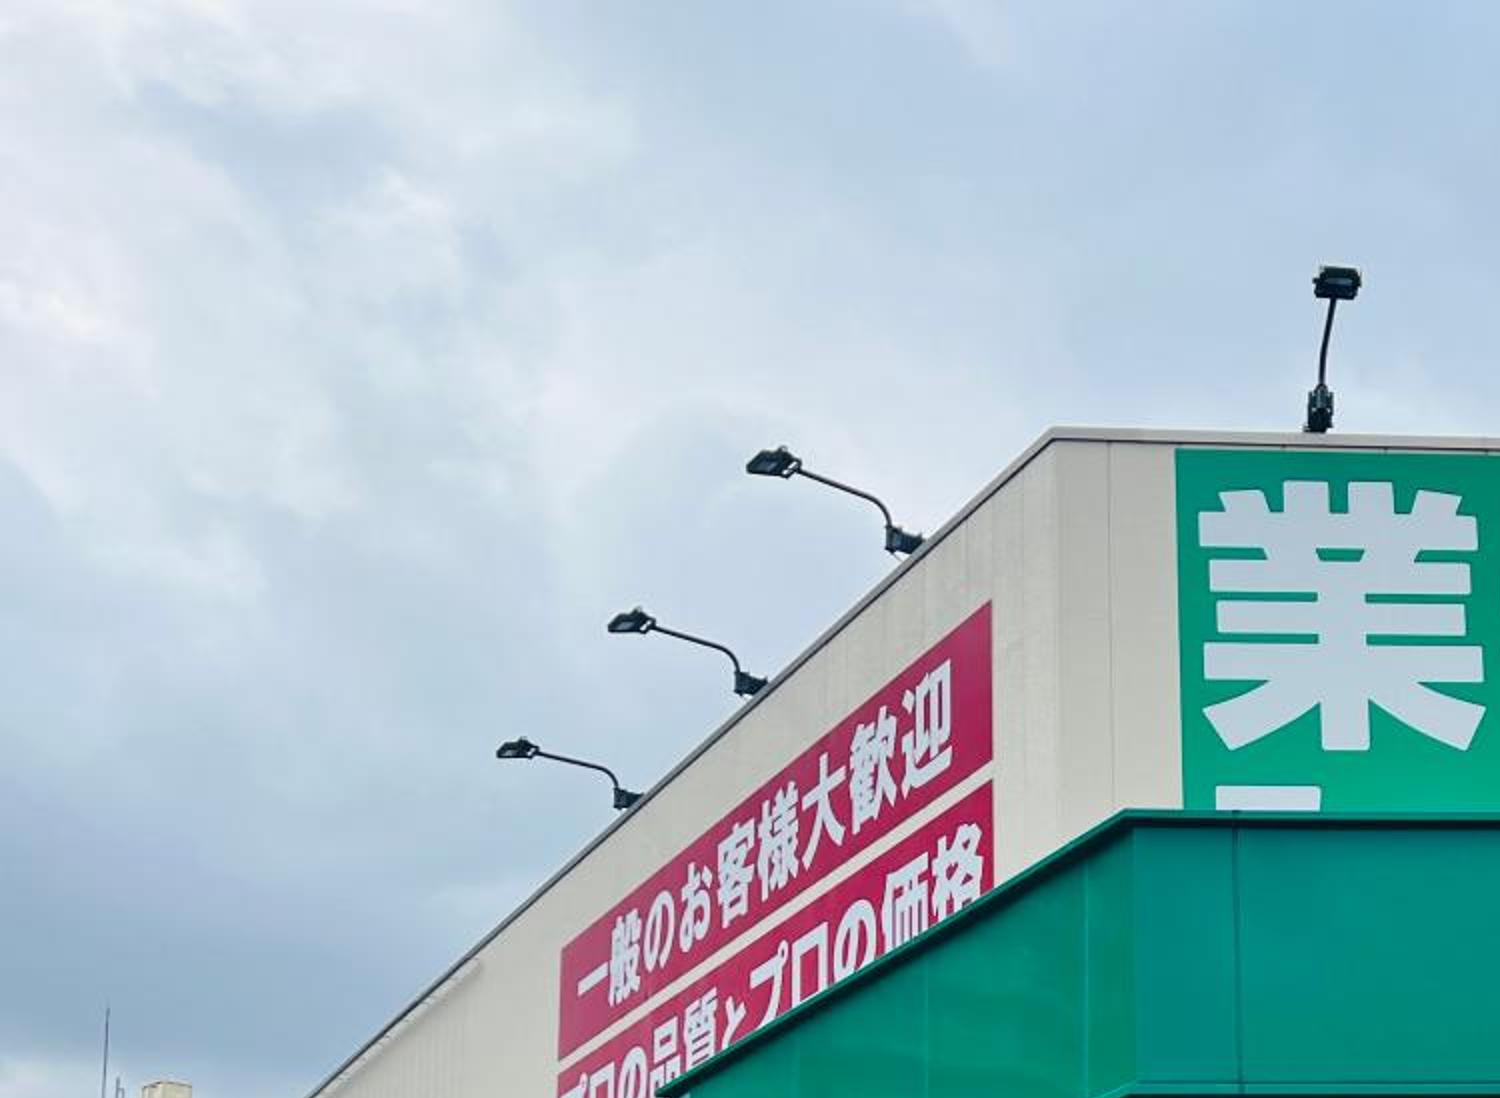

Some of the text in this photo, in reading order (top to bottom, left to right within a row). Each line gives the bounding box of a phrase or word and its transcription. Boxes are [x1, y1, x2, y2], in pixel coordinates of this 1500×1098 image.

[577, 658, 953, 1007] 一般のお客様大歓迎
